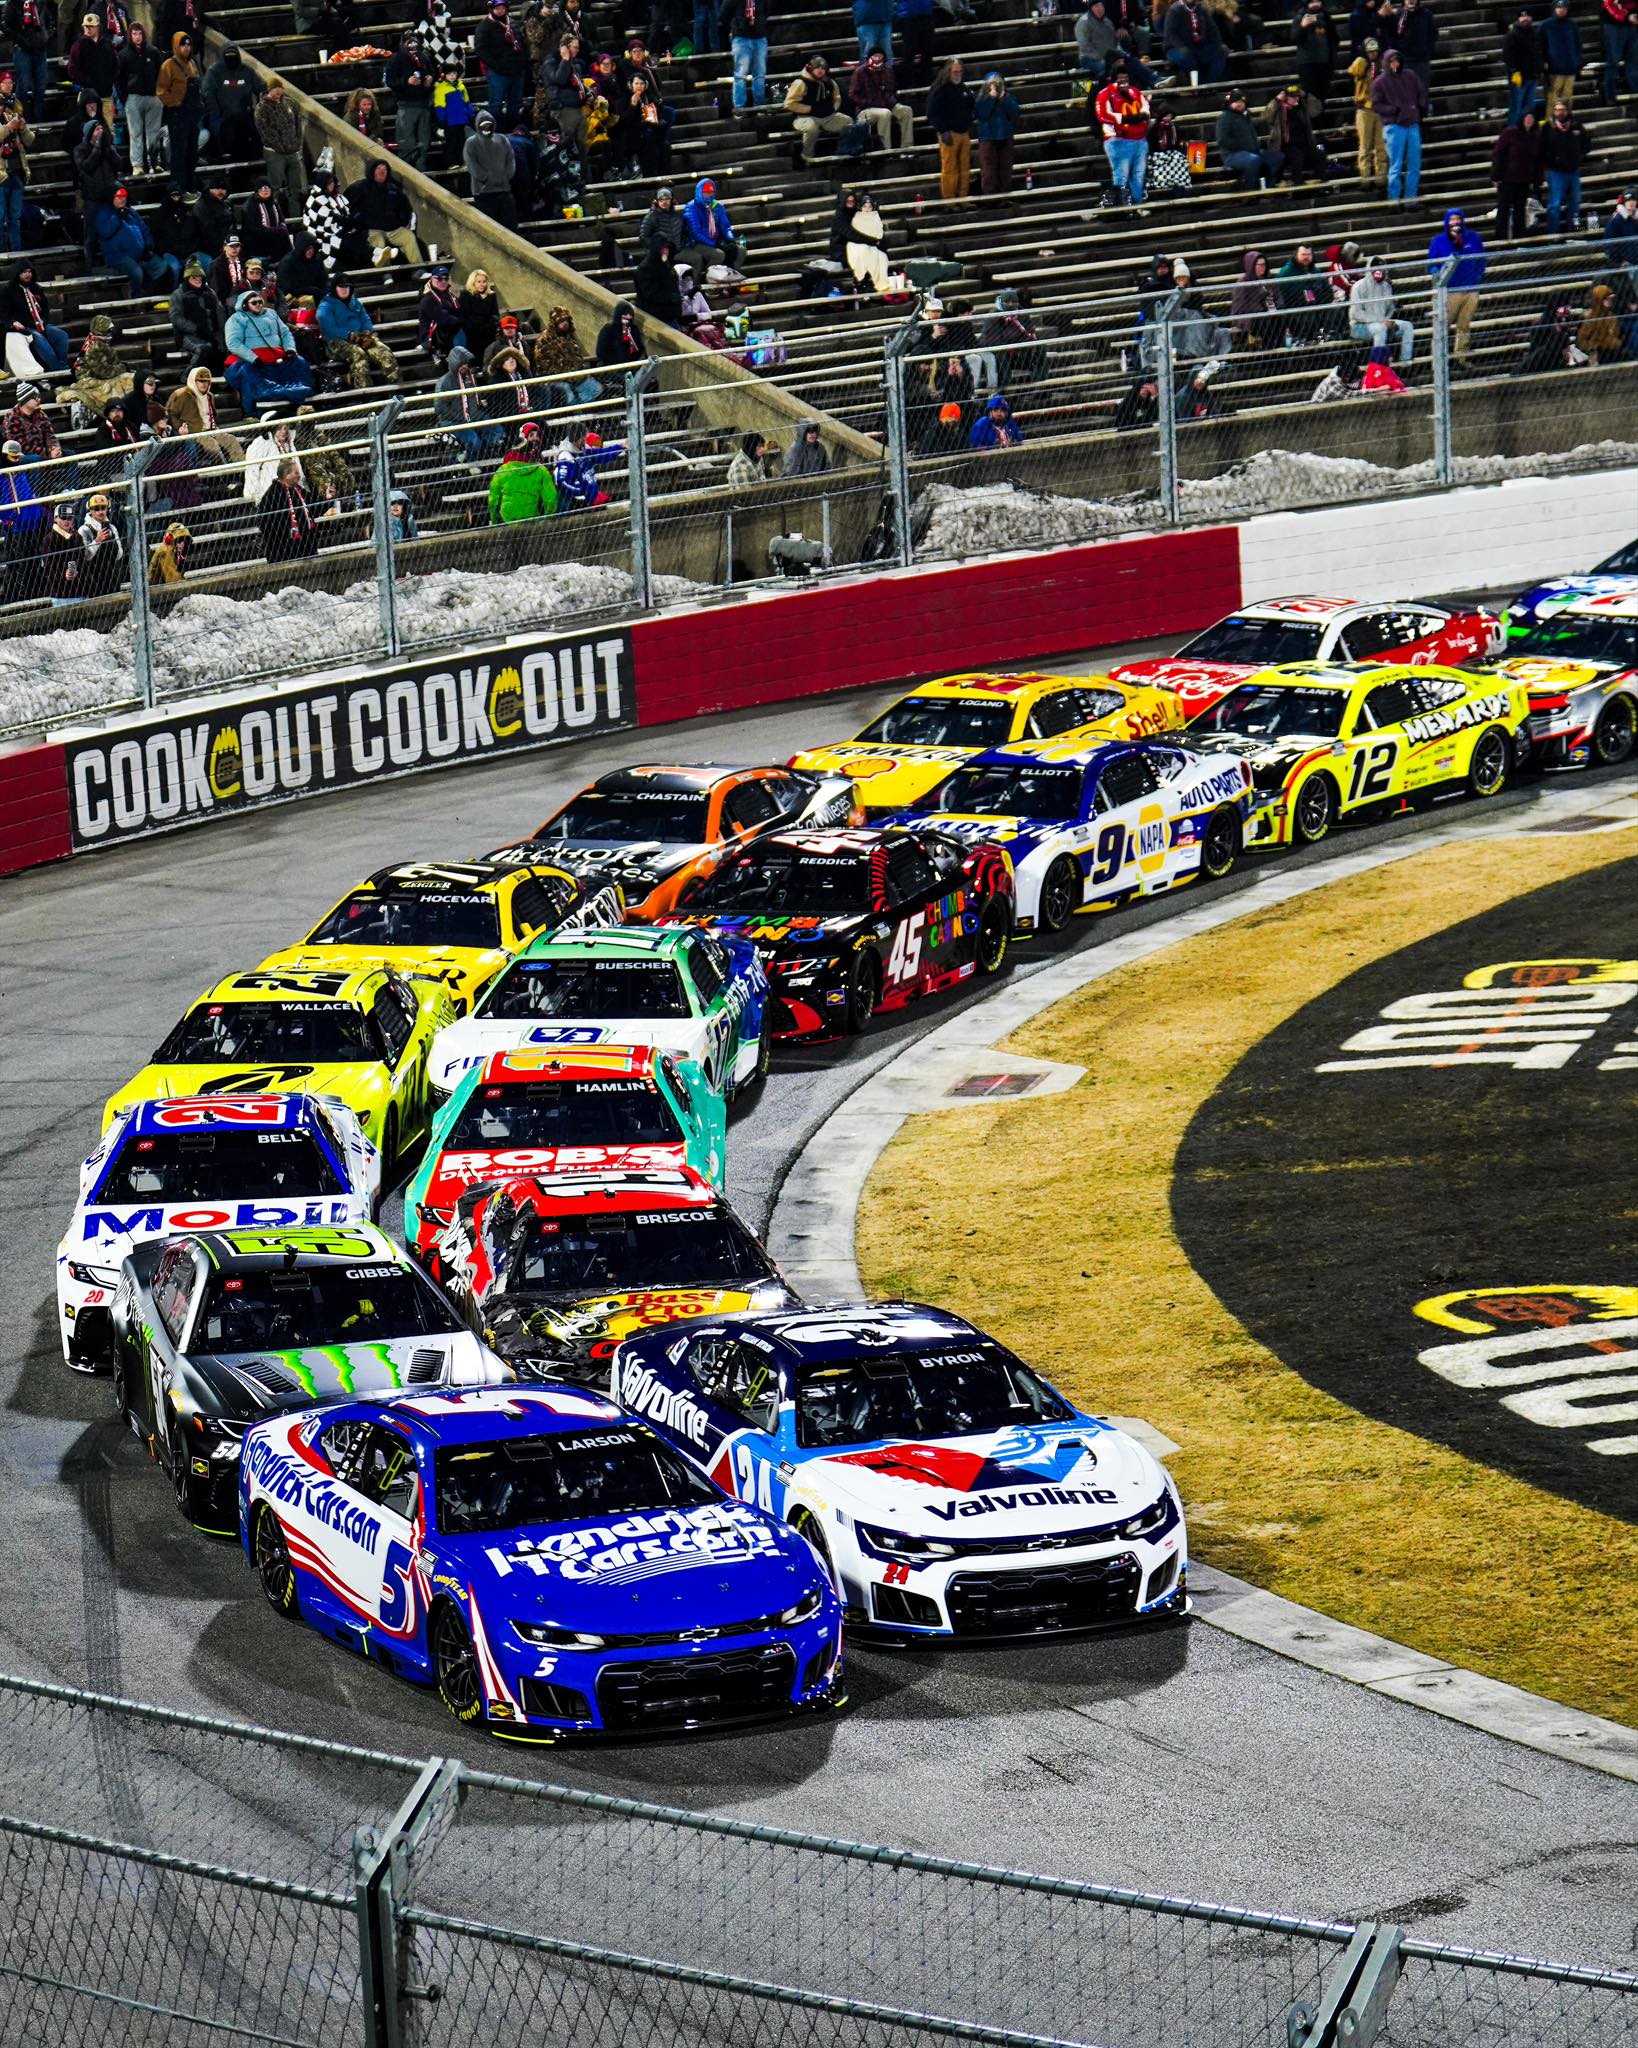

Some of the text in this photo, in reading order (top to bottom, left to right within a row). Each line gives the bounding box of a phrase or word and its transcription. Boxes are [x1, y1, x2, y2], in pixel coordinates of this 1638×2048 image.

[1293, 686, 1338, 697] BLANEY
[347, 637, 625, 775] COOK OUT
[958, 699, 1005, 708] LOGANO
[1125, 701, 1169, 741] Shell
[1401, 690, 1511, 747] MENARDS
[72, 694, 339, 839] COOK OUT
[1020, 767, 1073, 778] ELLIOTT
[1348, 740, 1399, 804] 12
[636, 791, 706, 802] CHASTAIN
[1180, 766, 1243, 812] AUTO PARTS
[1139, 822, 1166, 857] NAPA
[799, 856, 858, 866] REDDICK
[1092, 823, 1126, 886] 9
[419, 894, 492, 904] HOCEVAR
[887, 911, 926, 985] 45
[595, 961, 672, 970] BUESCHER
[281, 1002, 352, 1012] WALLACE
[576, 1082, 646, 1094] HAMLIN
[258, 1133, 303, 1144] BELL
[440, 1145, 687, 1172] BOB'S
[83, 1201, 349, 1242] Mobil
[635, 1210, 717, 1225] BRISCOE
[345, 1265, 403, 1281] GIBBS
[83, 1289, 105, 1303] 20
[625, 1291, 718, 1306] Bass
[634, 1303, 704, 1317] Pro
[918, 1352, 986, 1369] BYRON
[210, 1441, 243, 1461] 54
[557, 1433, 638, 1452] LARSON
[735, 1443, 774, 1515] 24
[922, 1486, 1118, 1521] Valvoline
[882, 1562, 911, 1586] 24
[380, 1535, 417, 1634] 5
[533, 1656, 559, 1678] 5
